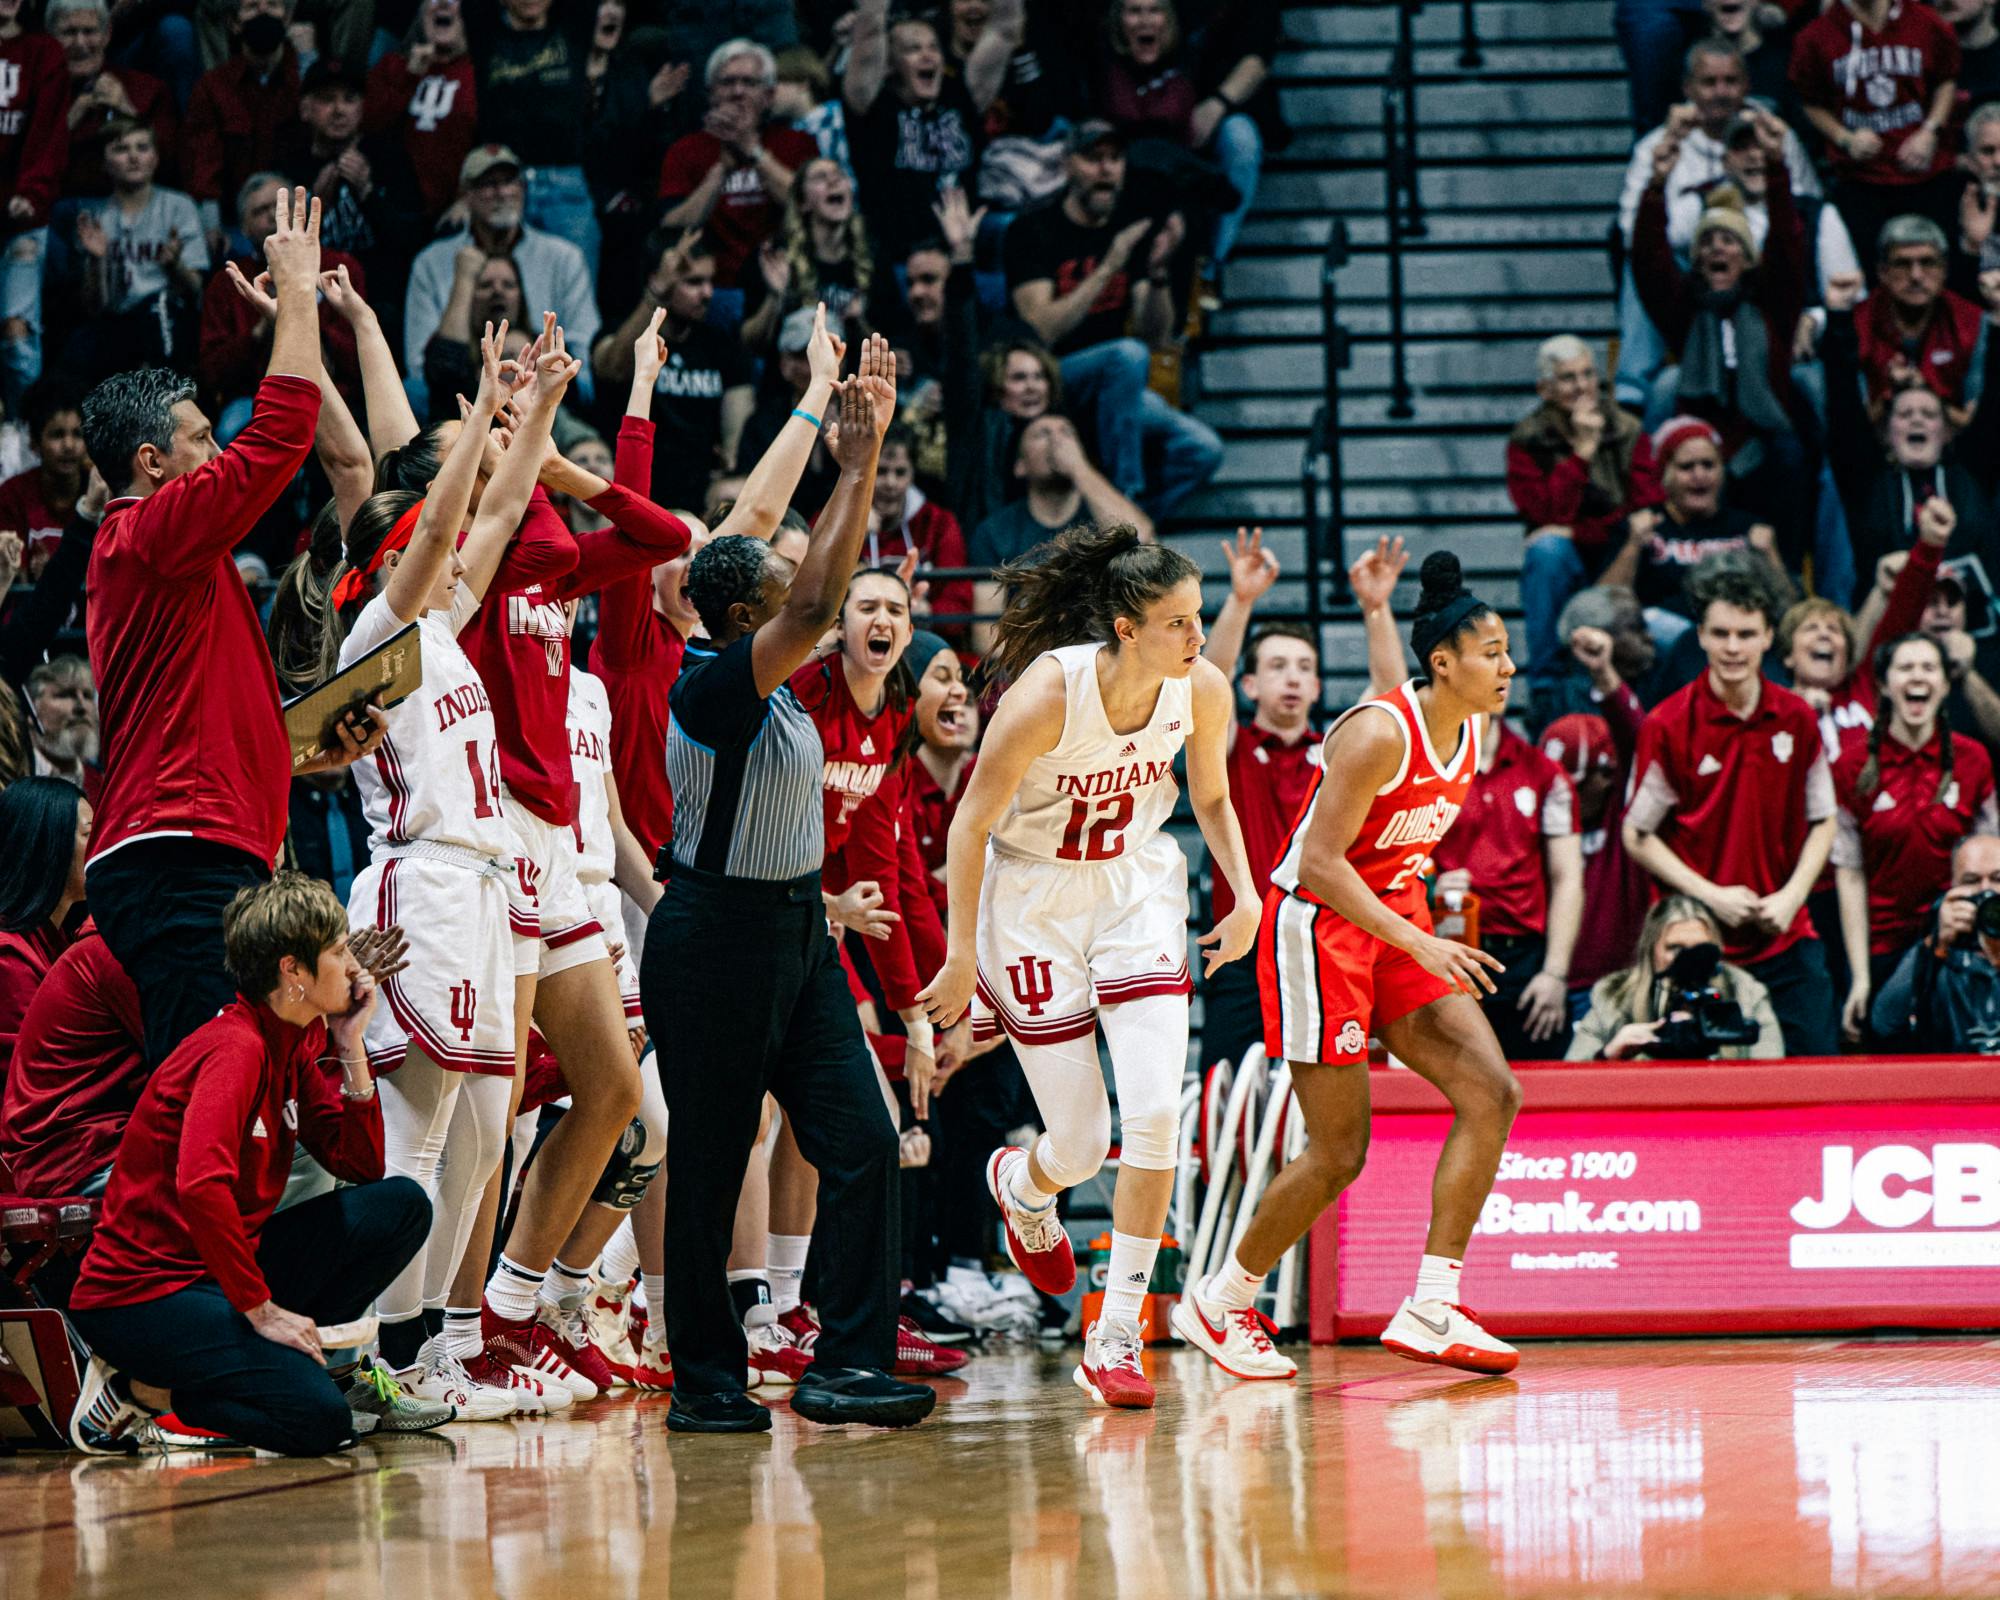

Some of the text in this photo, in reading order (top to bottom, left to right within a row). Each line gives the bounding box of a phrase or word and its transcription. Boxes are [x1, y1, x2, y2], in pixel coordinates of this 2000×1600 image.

[1055, 759, 1174, 798] INDIAN
[1055, 792, 1135, 861] 12
[1495, 1151, 1638, 1181] Since 1900
[1472, 1190, 1702, 1234] Bank.com
